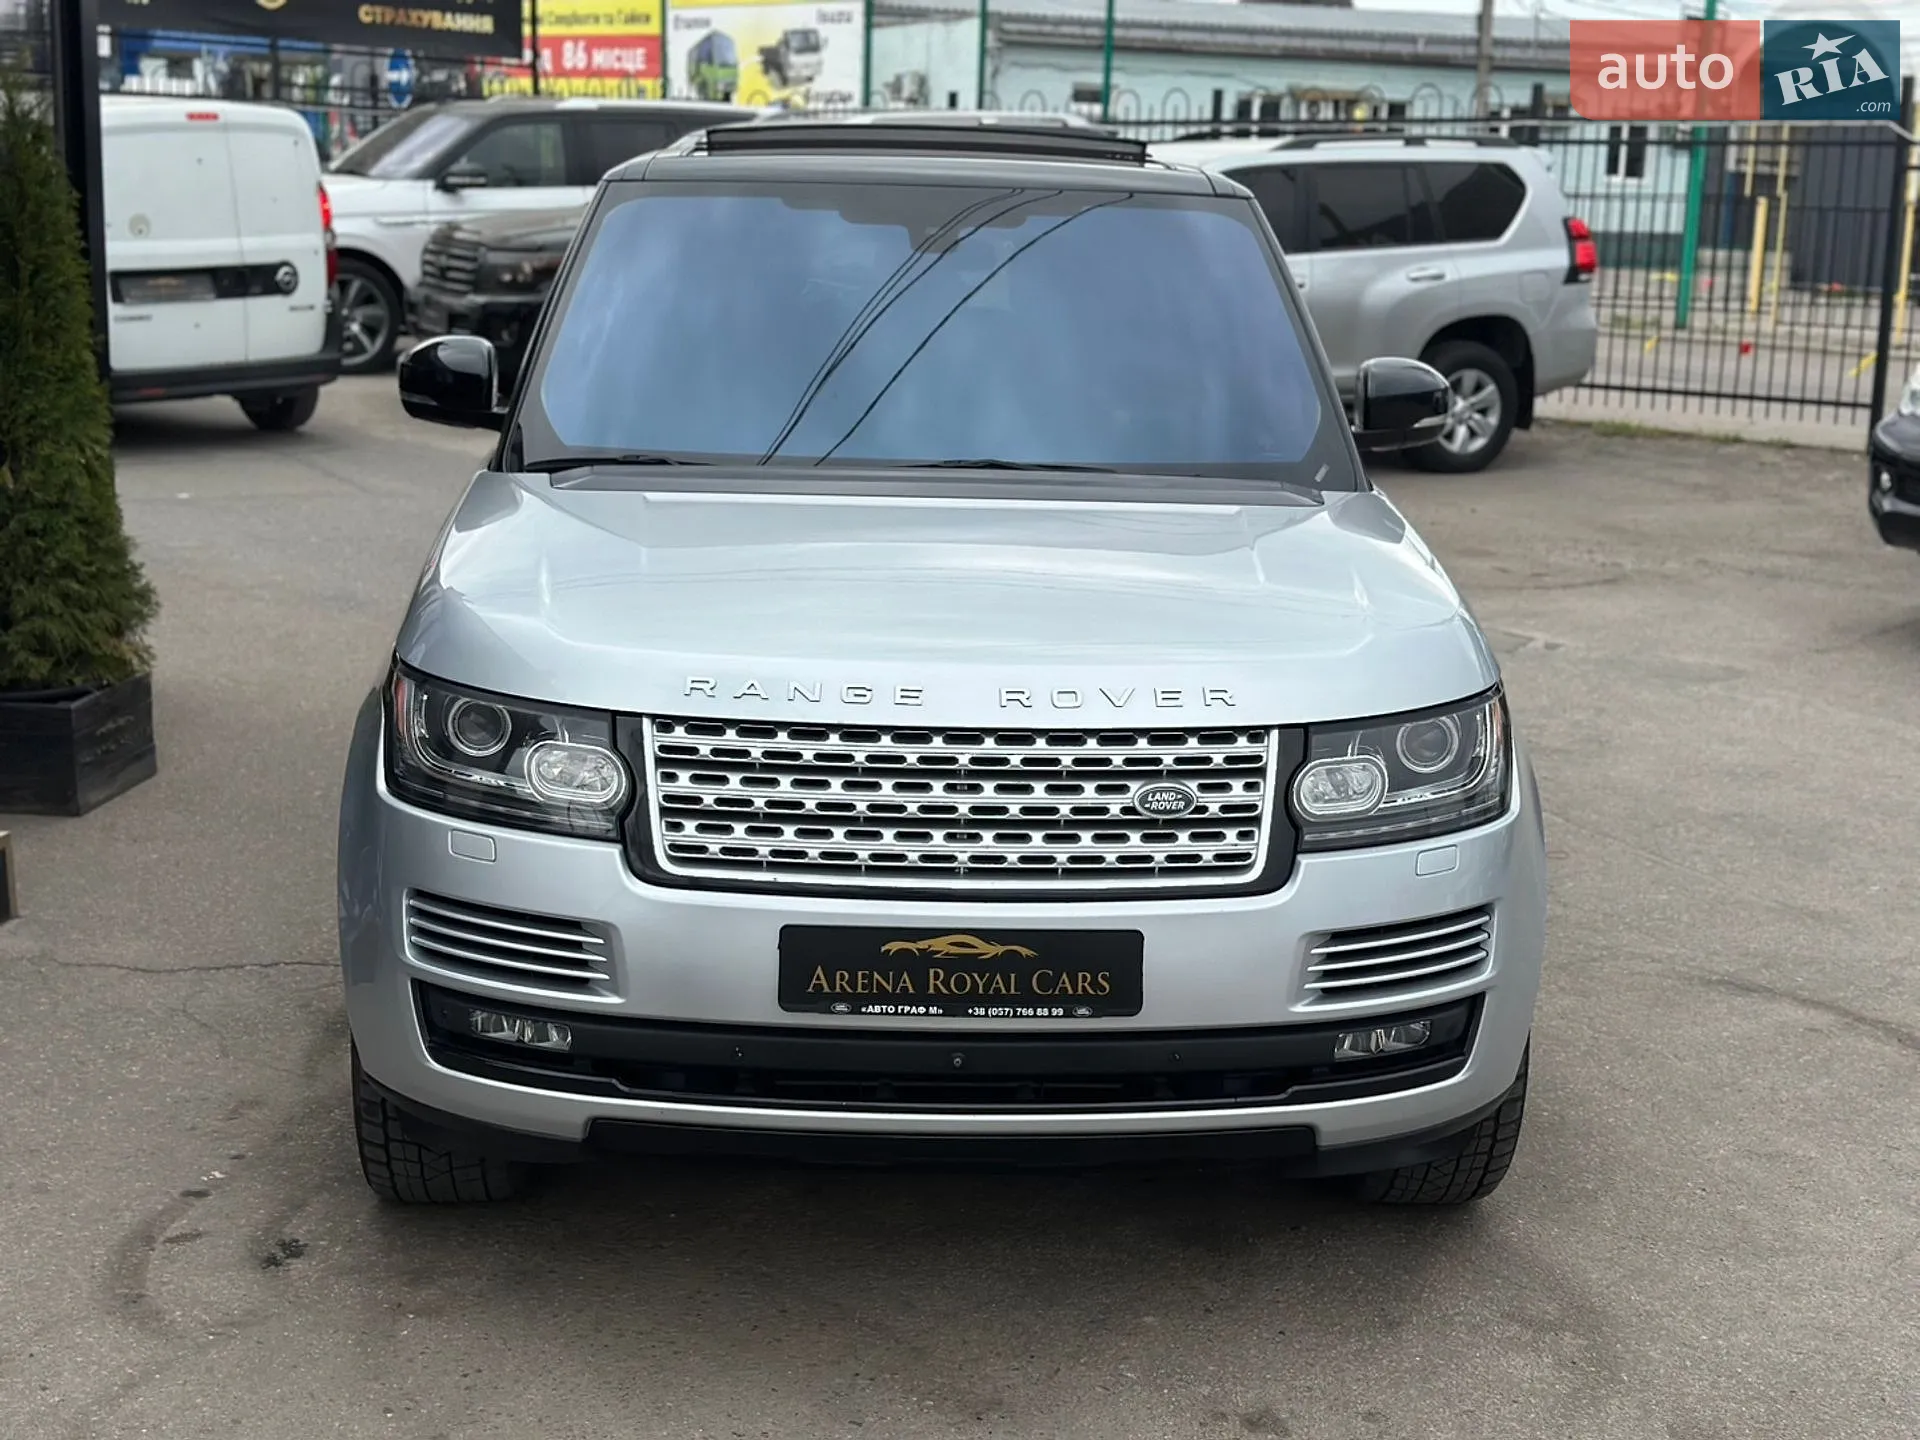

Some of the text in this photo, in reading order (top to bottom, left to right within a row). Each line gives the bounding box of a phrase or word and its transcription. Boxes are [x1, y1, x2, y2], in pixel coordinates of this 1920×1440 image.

[358, 4, 494, 34] СТРАХУВАННЯ
[562, 39, 589, 70] 86
[684, 676, 1237, 709] RANGE ROVER
[806, 965, 1111, 996] ARENA ROYAL CARS
[898, 1005, 927, 1015] ГРАФ
[968, 1006, 986, 1016] +38
[1015, 1007, 1034, 1016] 766
[1036, 1007, 1049, 1016] 88
[1051, 1007, 1064, 1016] 99
